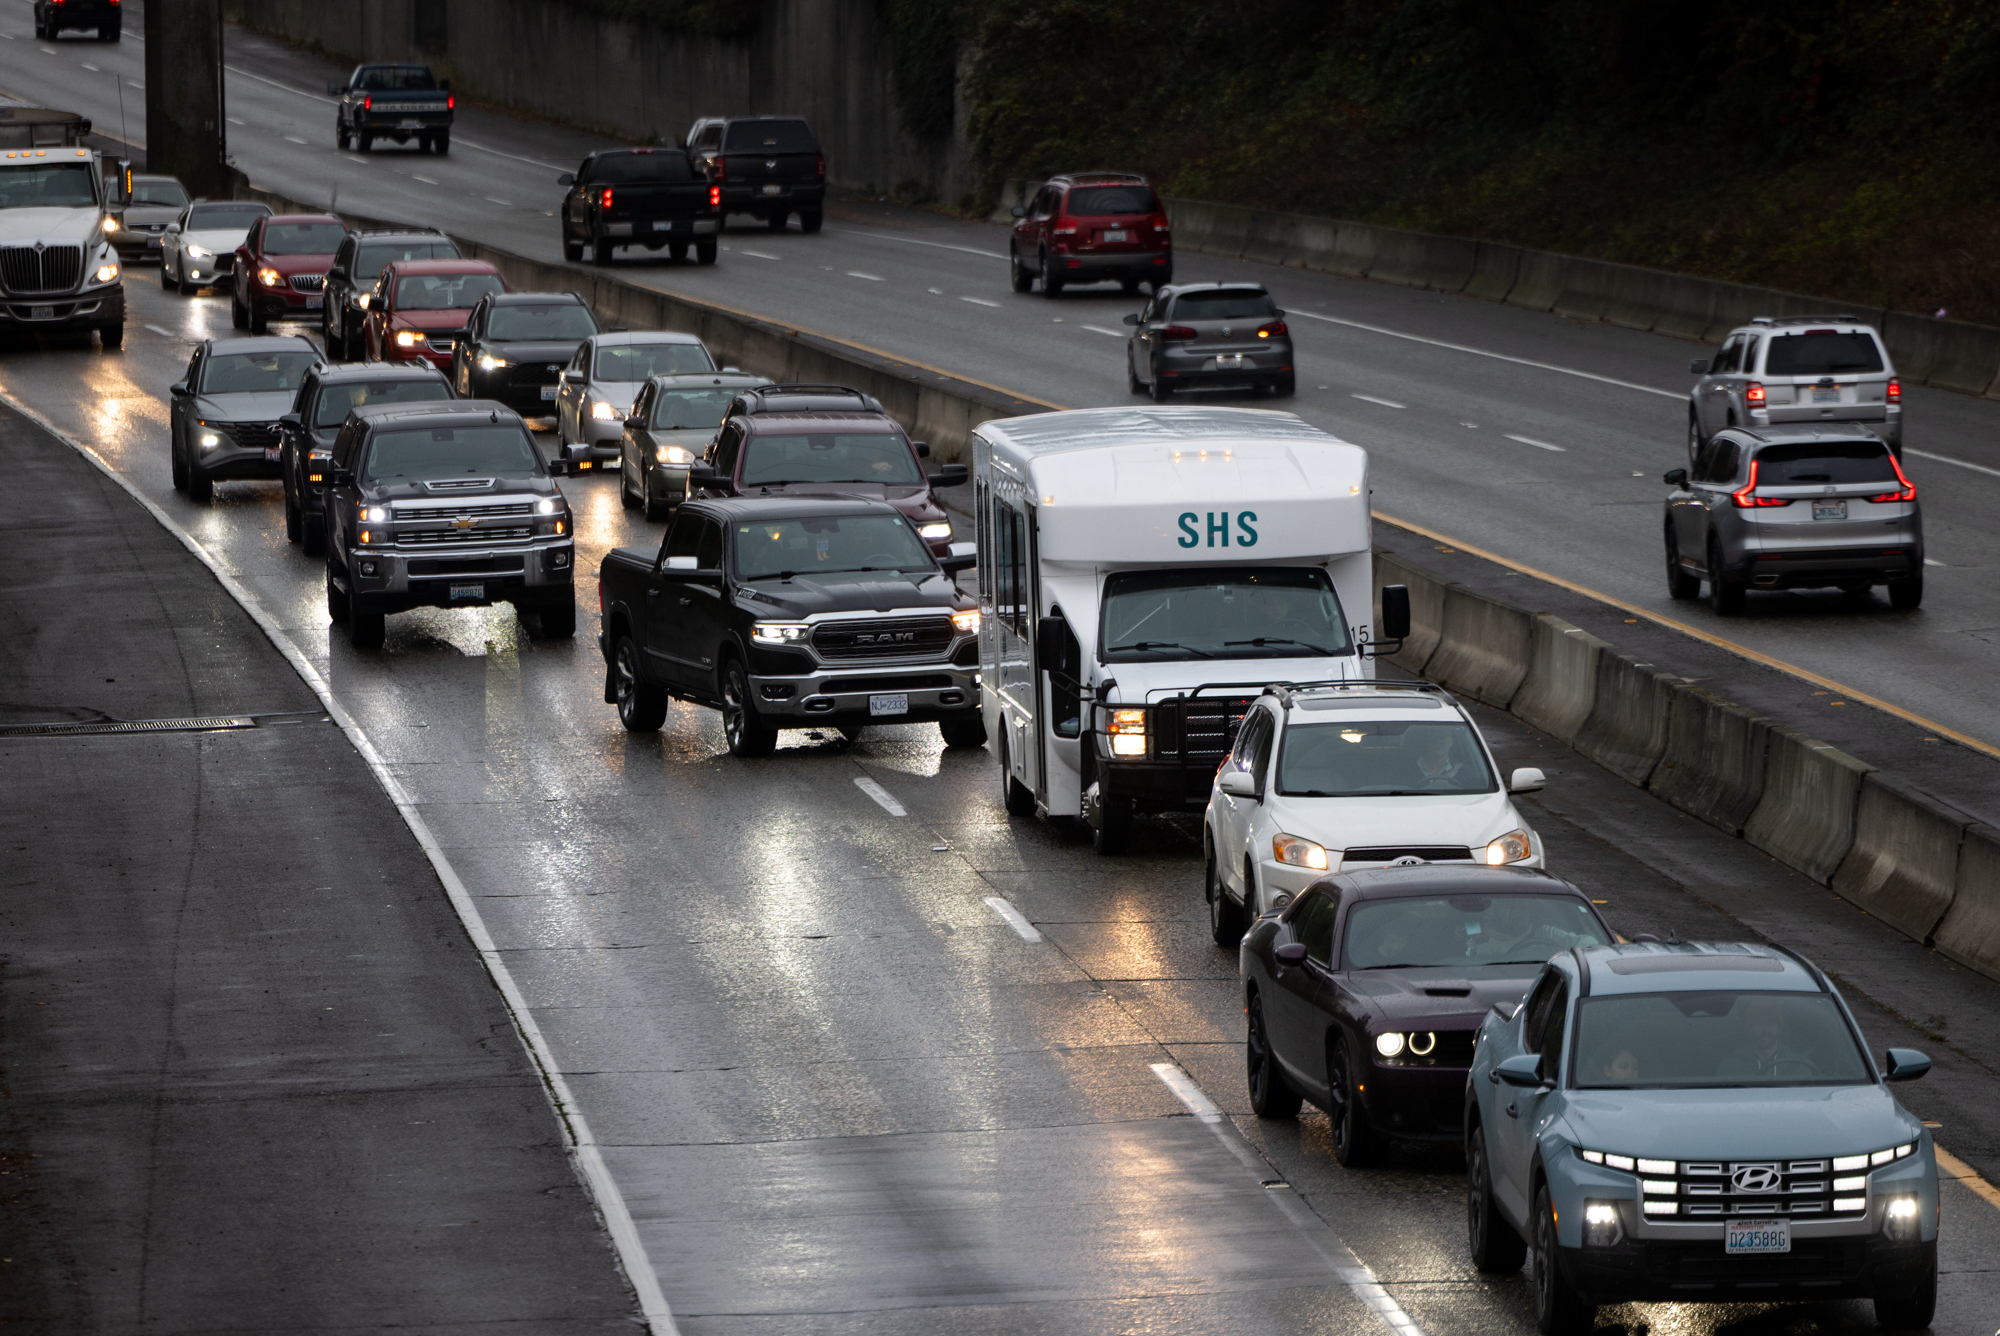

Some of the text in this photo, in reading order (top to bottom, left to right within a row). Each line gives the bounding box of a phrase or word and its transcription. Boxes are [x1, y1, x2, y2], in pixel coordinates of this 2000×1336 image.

[1177, 511, 1258, 549] SHS
[857, 633, 914, 644] RAM
[1351, 625, 1369, 643] 15
[1730, 1231, 1786, 1248] D23588G
